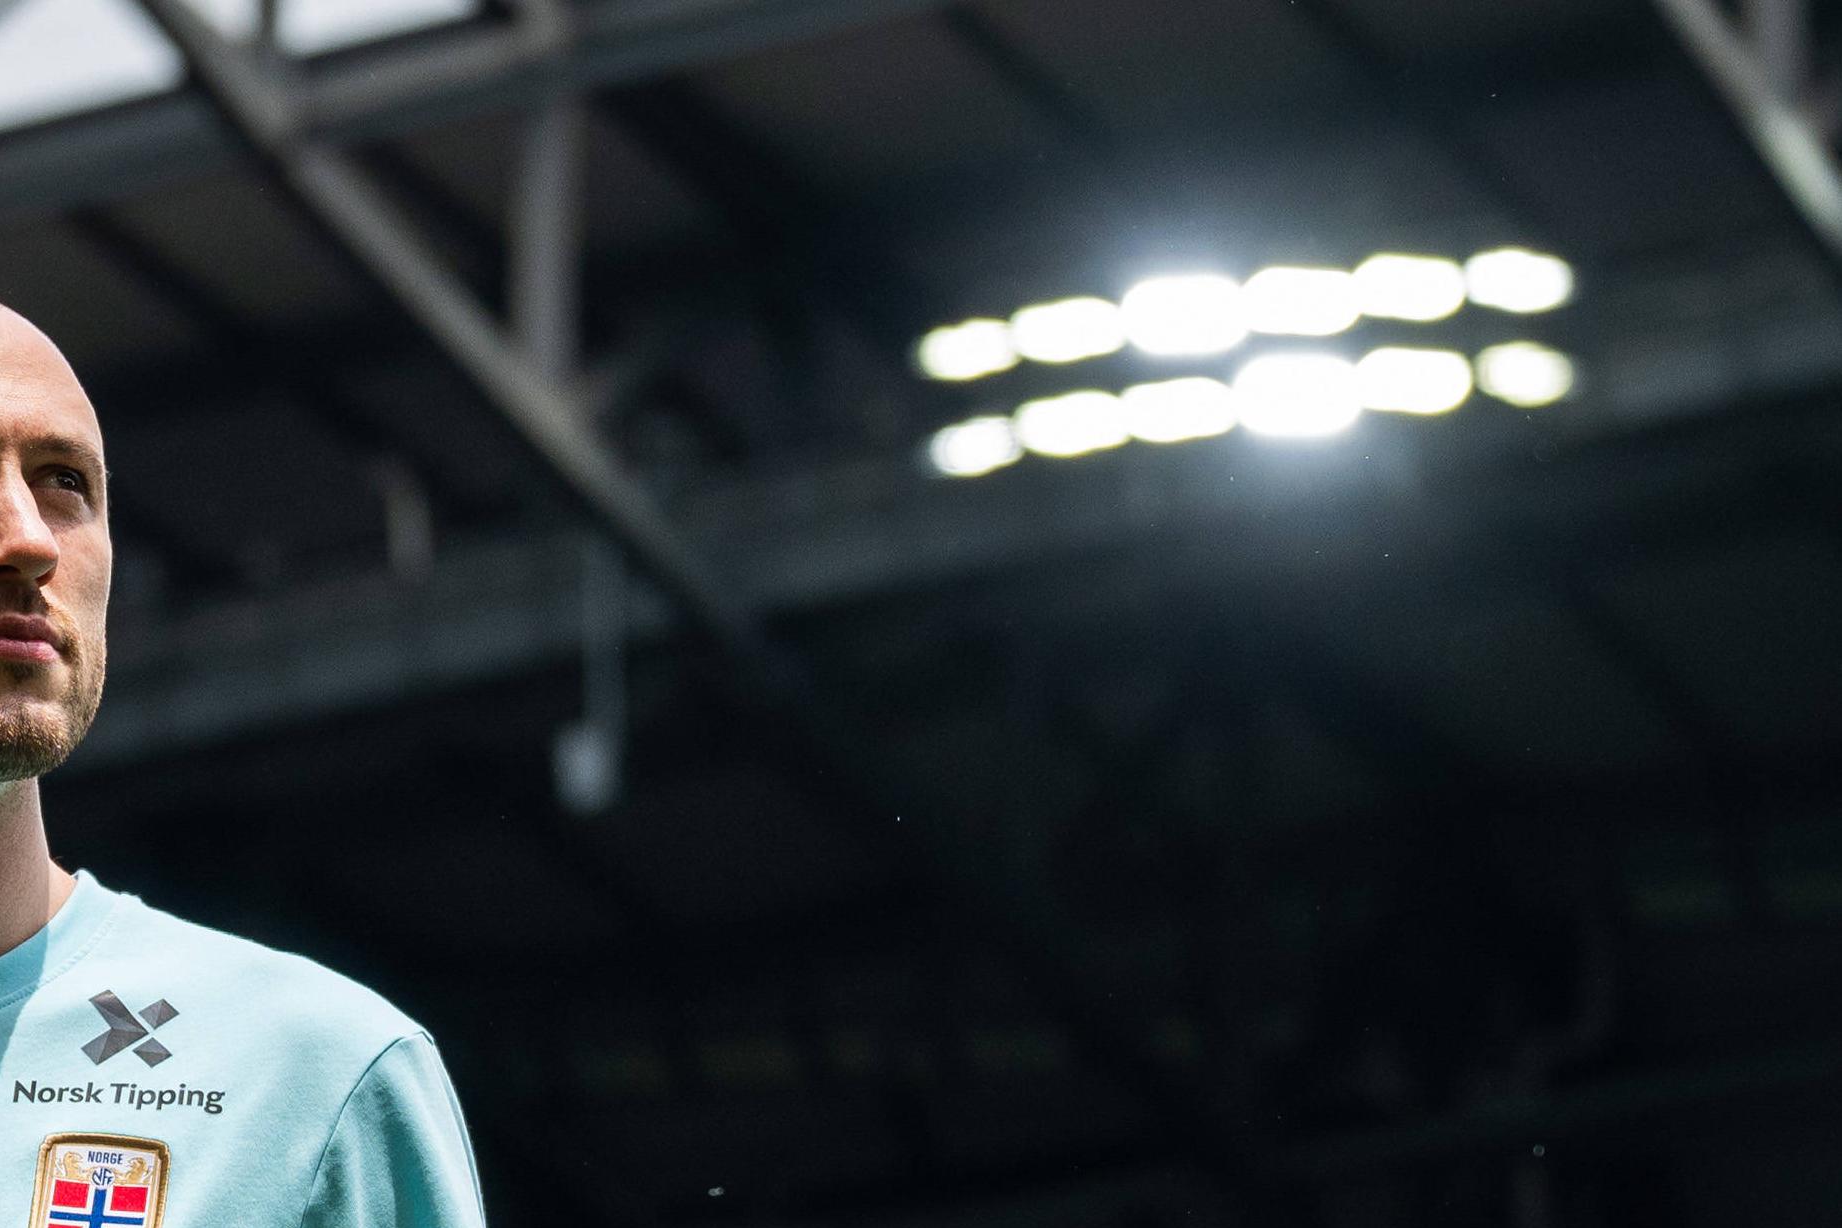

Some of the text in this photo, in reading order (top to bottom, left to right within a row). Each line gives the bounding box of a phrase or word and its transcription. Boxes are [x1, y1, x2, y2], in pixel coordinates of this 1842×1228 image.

[12, 1079, 226, 1115] Norsk Tipping
[87, 1150, 124, 1165] NORGE
